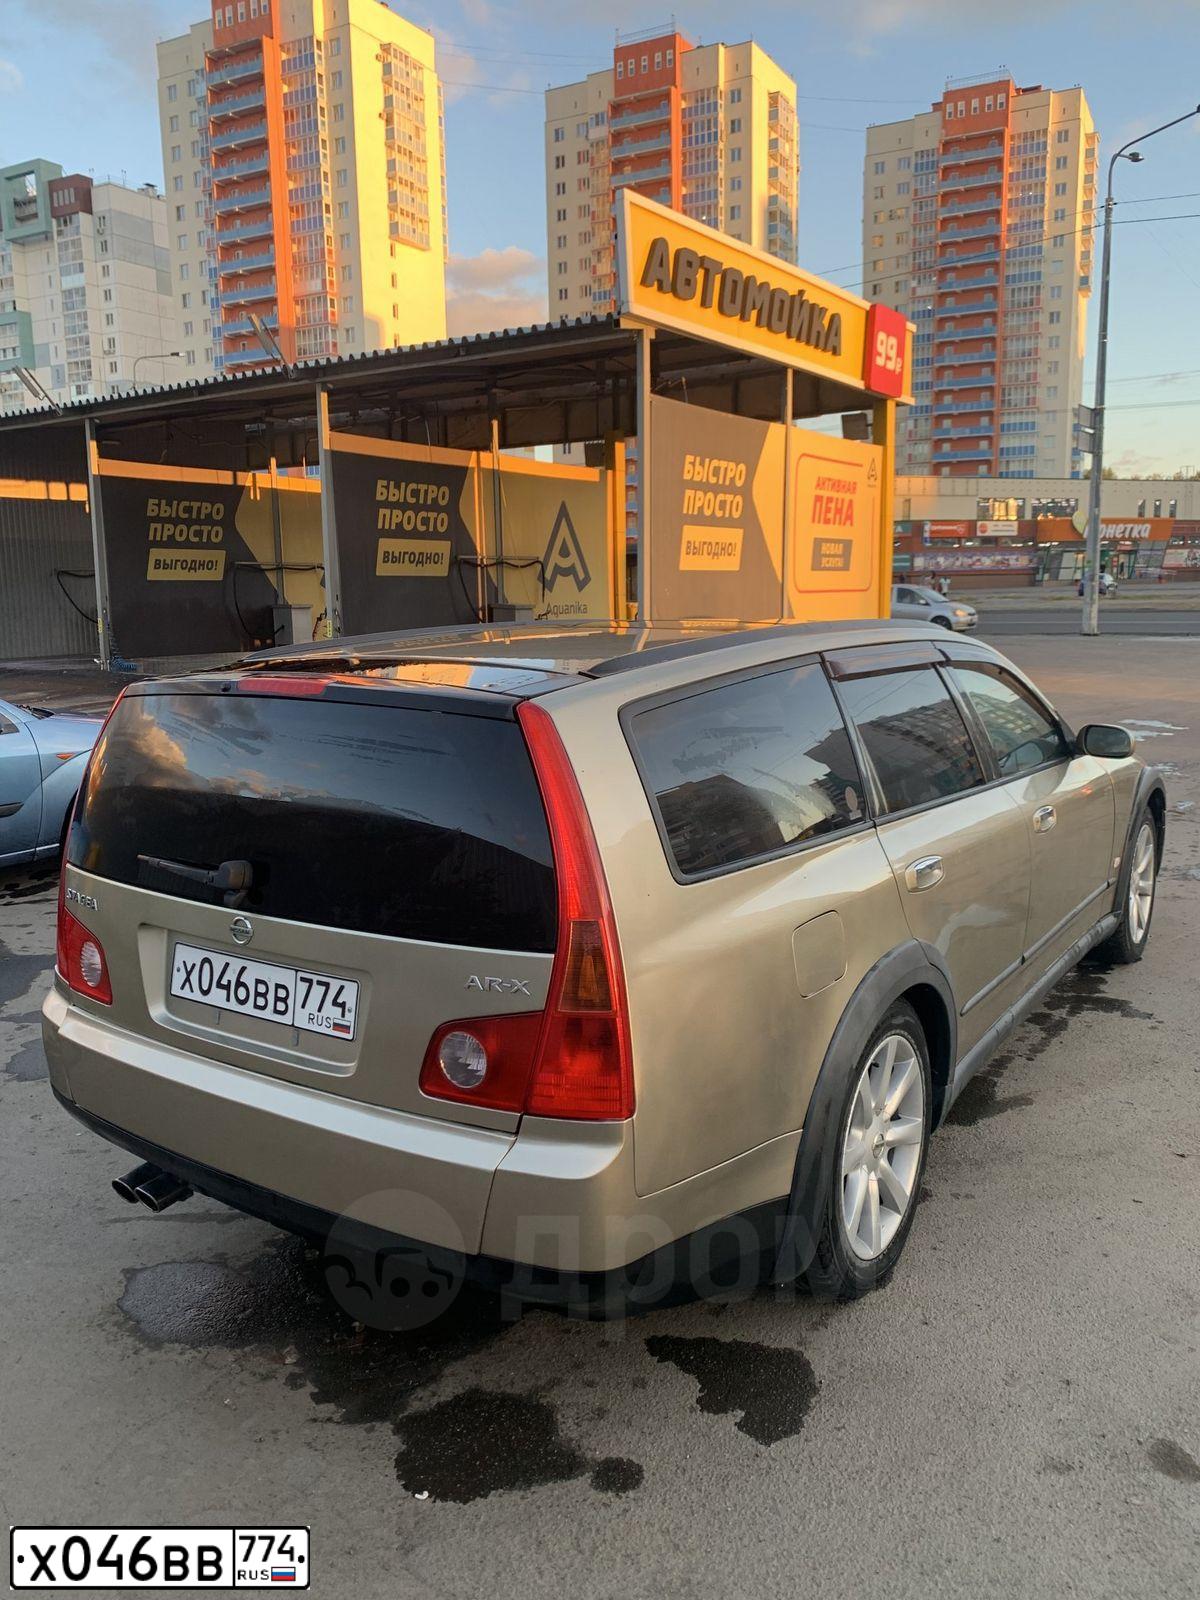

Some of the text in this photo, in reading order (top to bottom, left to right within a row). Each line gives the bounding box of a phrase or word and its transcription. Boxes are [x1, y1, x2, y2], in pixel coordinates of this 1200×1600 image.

[640, 237, 842, 356] АВТОМОЙКА
[683, 454, 746, 487] БЫСТРО
[376, 479, 449, 506] БЫСТРО
[815, 476, 857, 494] АКТИВНАЯ
[146, 498, 224, 520] БЫСТРО
[683, 489, 743, 518] ПРОСТО
[811, 494, 854, 527] ПЕНА
[377, 508, 448, 533] ПРОСТО
[149, 523, 223, 543] ПРОСТО
[382, 550, 444, 567] ВЫГОДНО!
[686, 540, 737, 560] ВЫГОДНО!
[153, 559, 218, 573] ВЫГОДНО!
[180, 957, 346, 1018] Х046ВВ 774
[464, 975, 531, 996] AR-X
[307, 1013, 332, 1029] RUS
